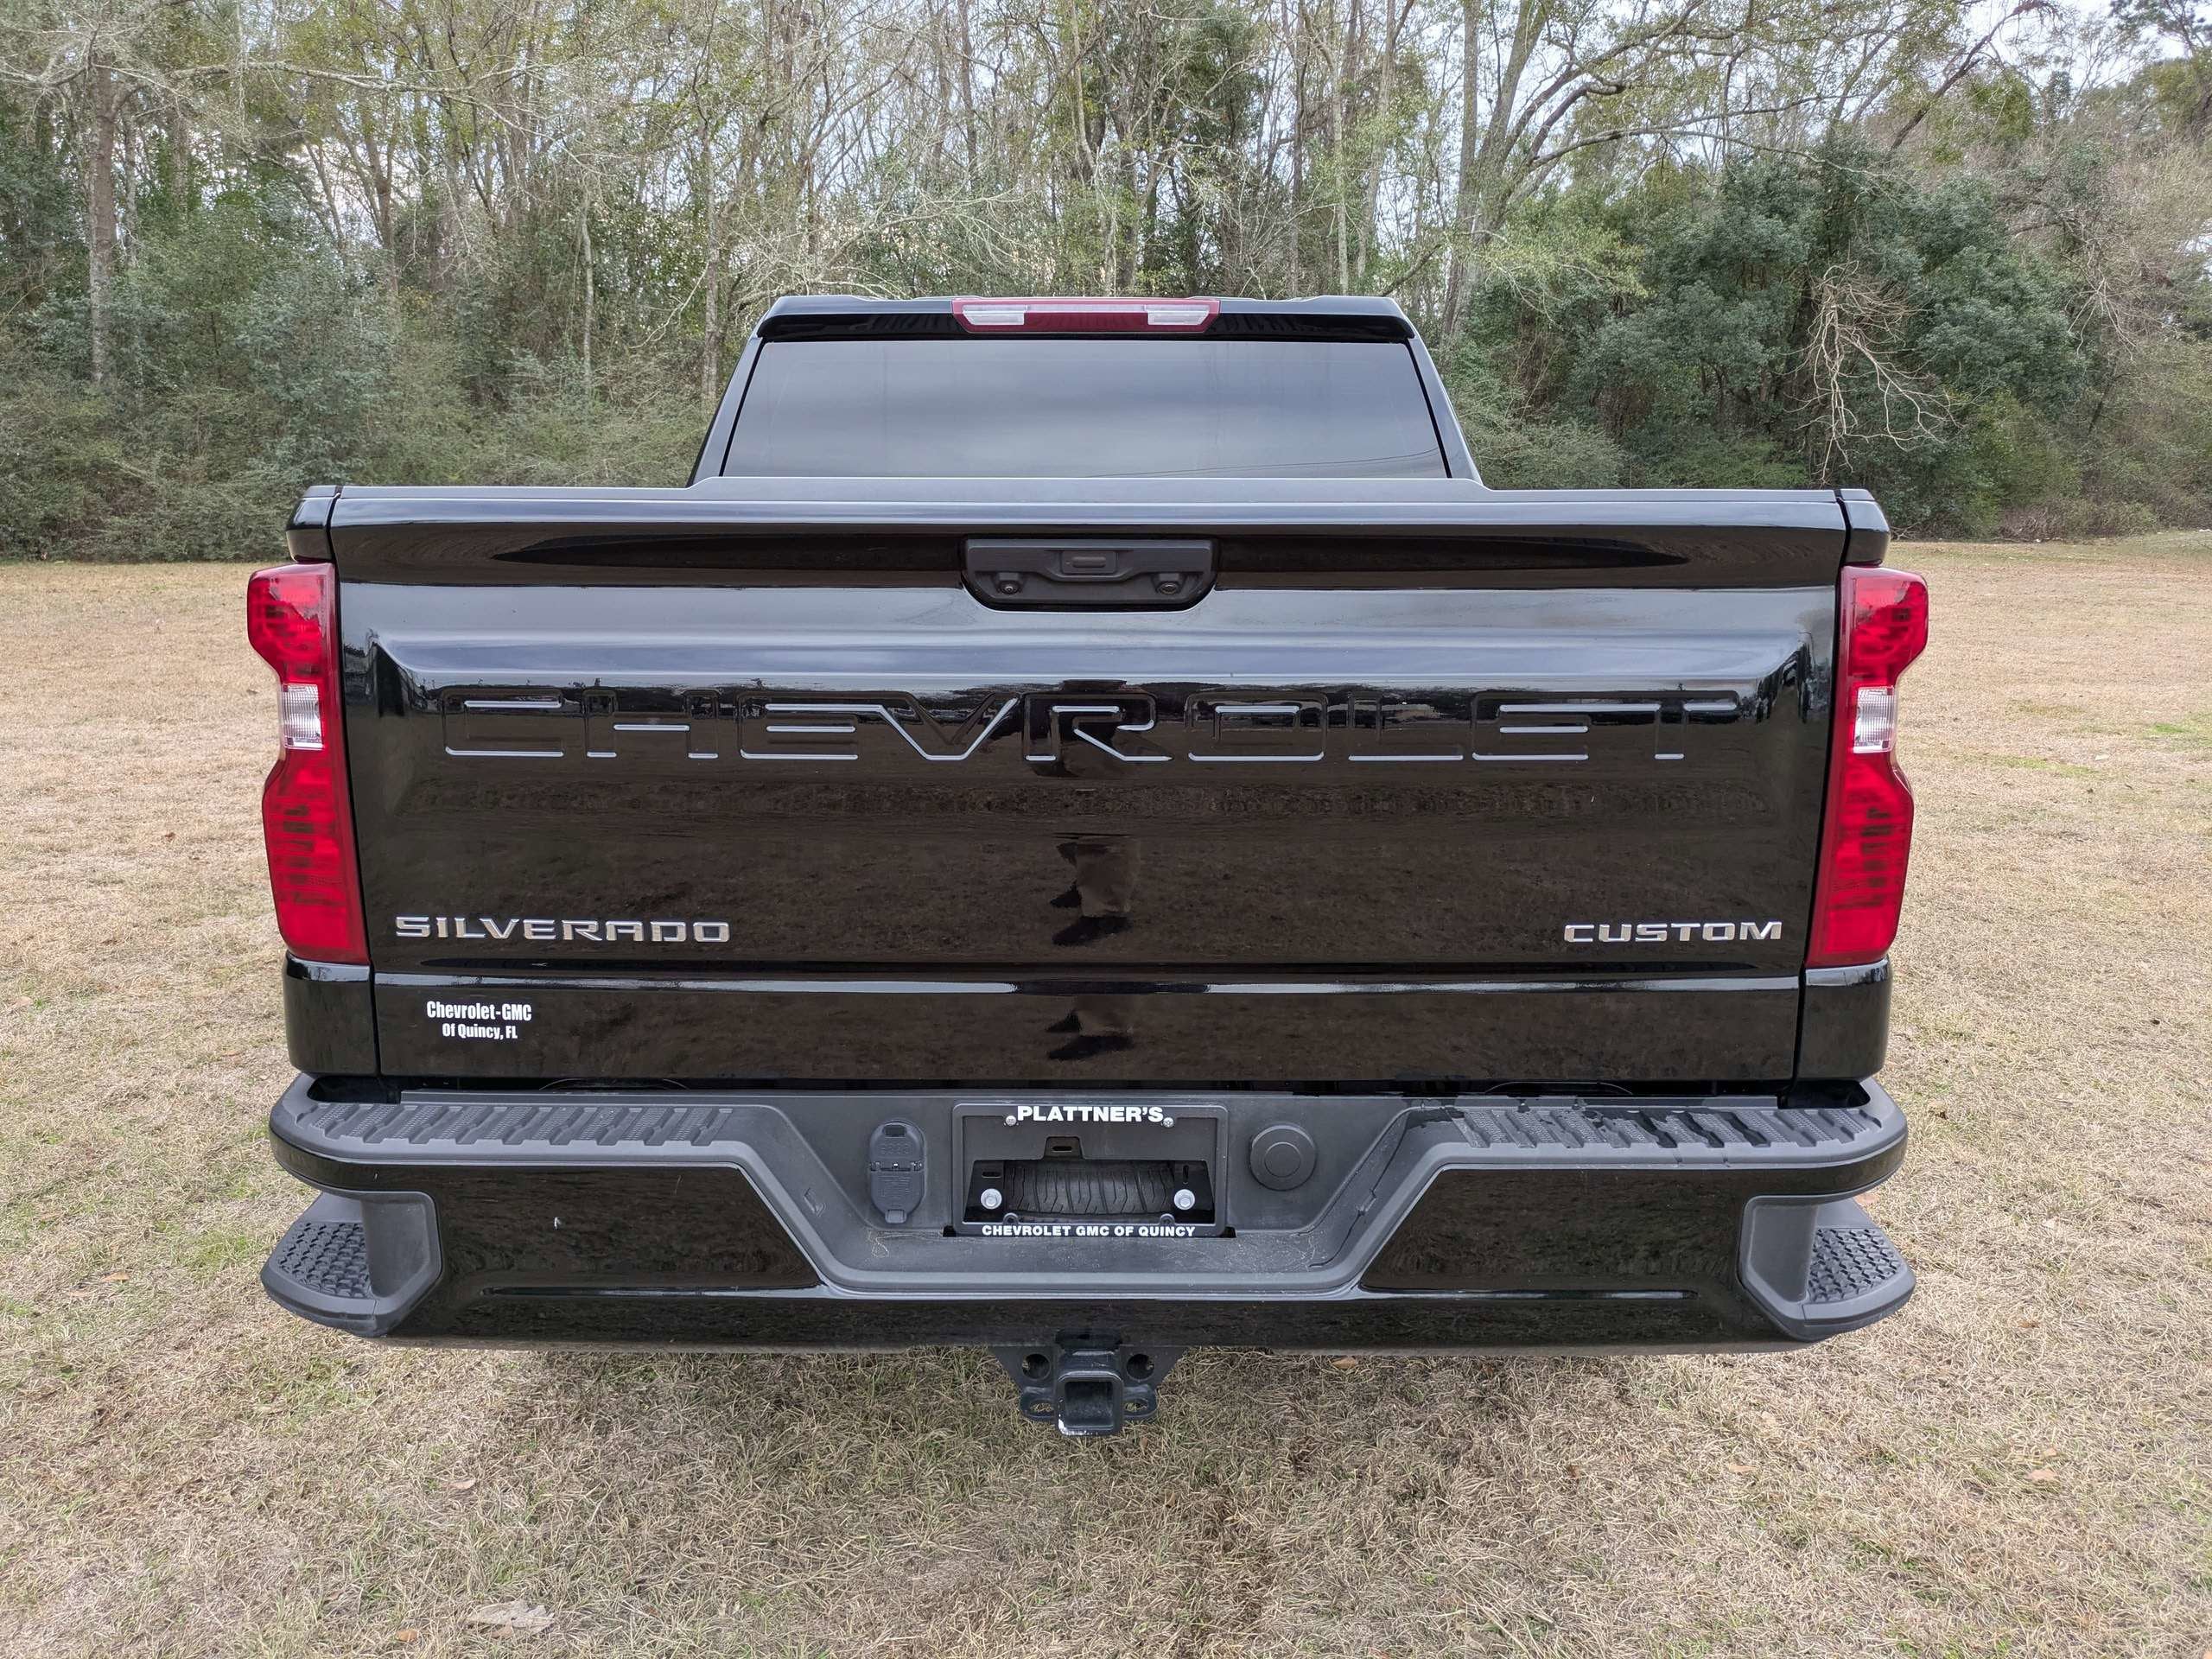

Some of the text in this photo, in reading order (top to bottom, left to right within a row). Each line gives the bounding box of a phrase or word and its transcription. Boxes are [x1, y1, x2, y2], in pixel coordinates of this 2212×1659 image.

[443, 690, 1739, 764] CHEVROLET
[396, 916, 730, 943] SILVERADO
[1563, 920, 1783, 943] CUSTOM
[426, 1001, 532, 1021] Chevrolet-GMC
[442, 1023, 518, 1040] Of Quincy, FL
[1017, 1105, 1164, 1122] PLATTNER'S
[982, 1224, 1196, 1237] CHEVROLET GMC OF QUINCY
